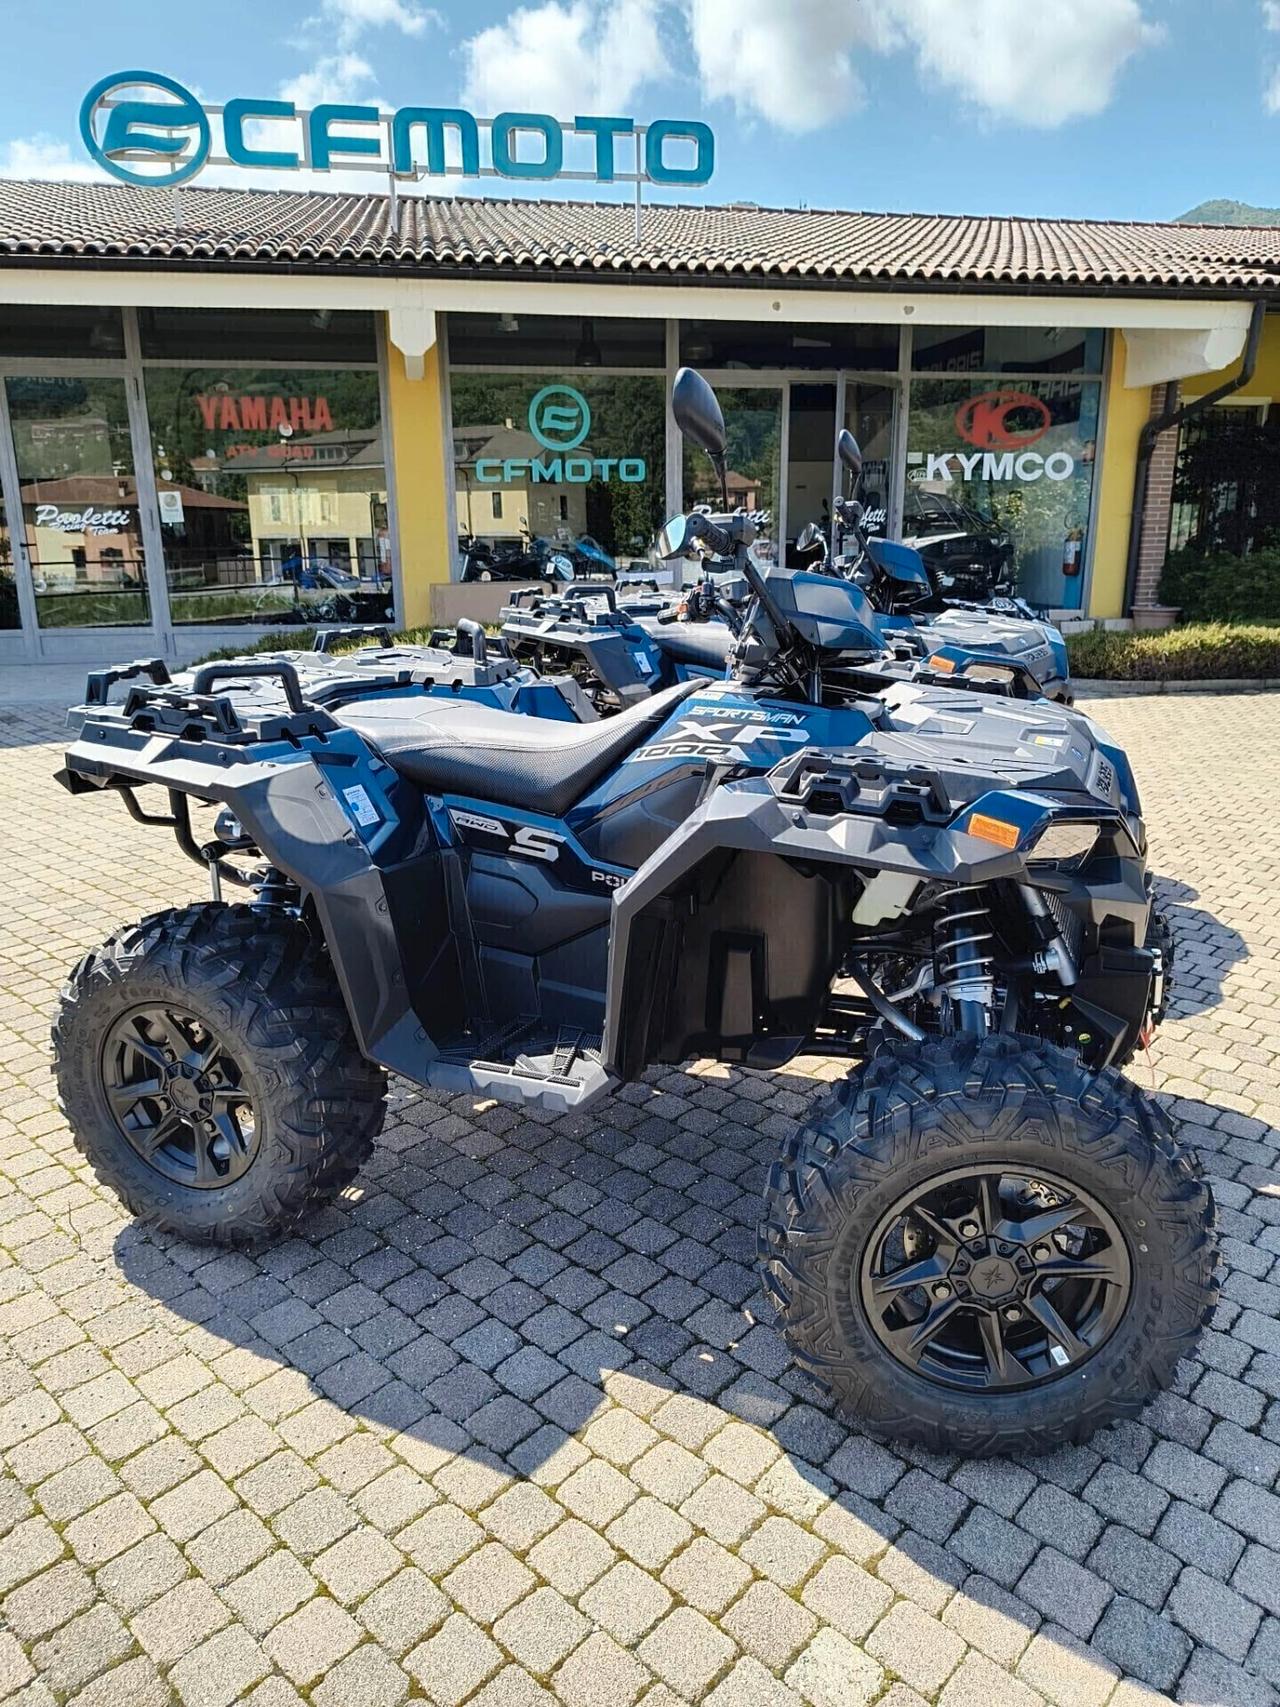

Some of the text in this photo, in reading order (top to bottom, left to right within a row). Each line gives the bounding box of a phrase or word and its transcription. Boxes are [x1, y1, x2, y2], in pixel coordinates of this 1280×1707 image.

[223, 98, 714, 187] CFMOTO
[196, 395, 335, 431] YAMAHA
[475, 458, 646, 483] CFMOTO
[926, 452, 1075, 482] KYMCO
[687, 705, 807, 725] SPORTSMAN
[662, 720, 811, 743] XP
[635, 746, 732, 760] 1000
[508, 826, 567, 863] S
